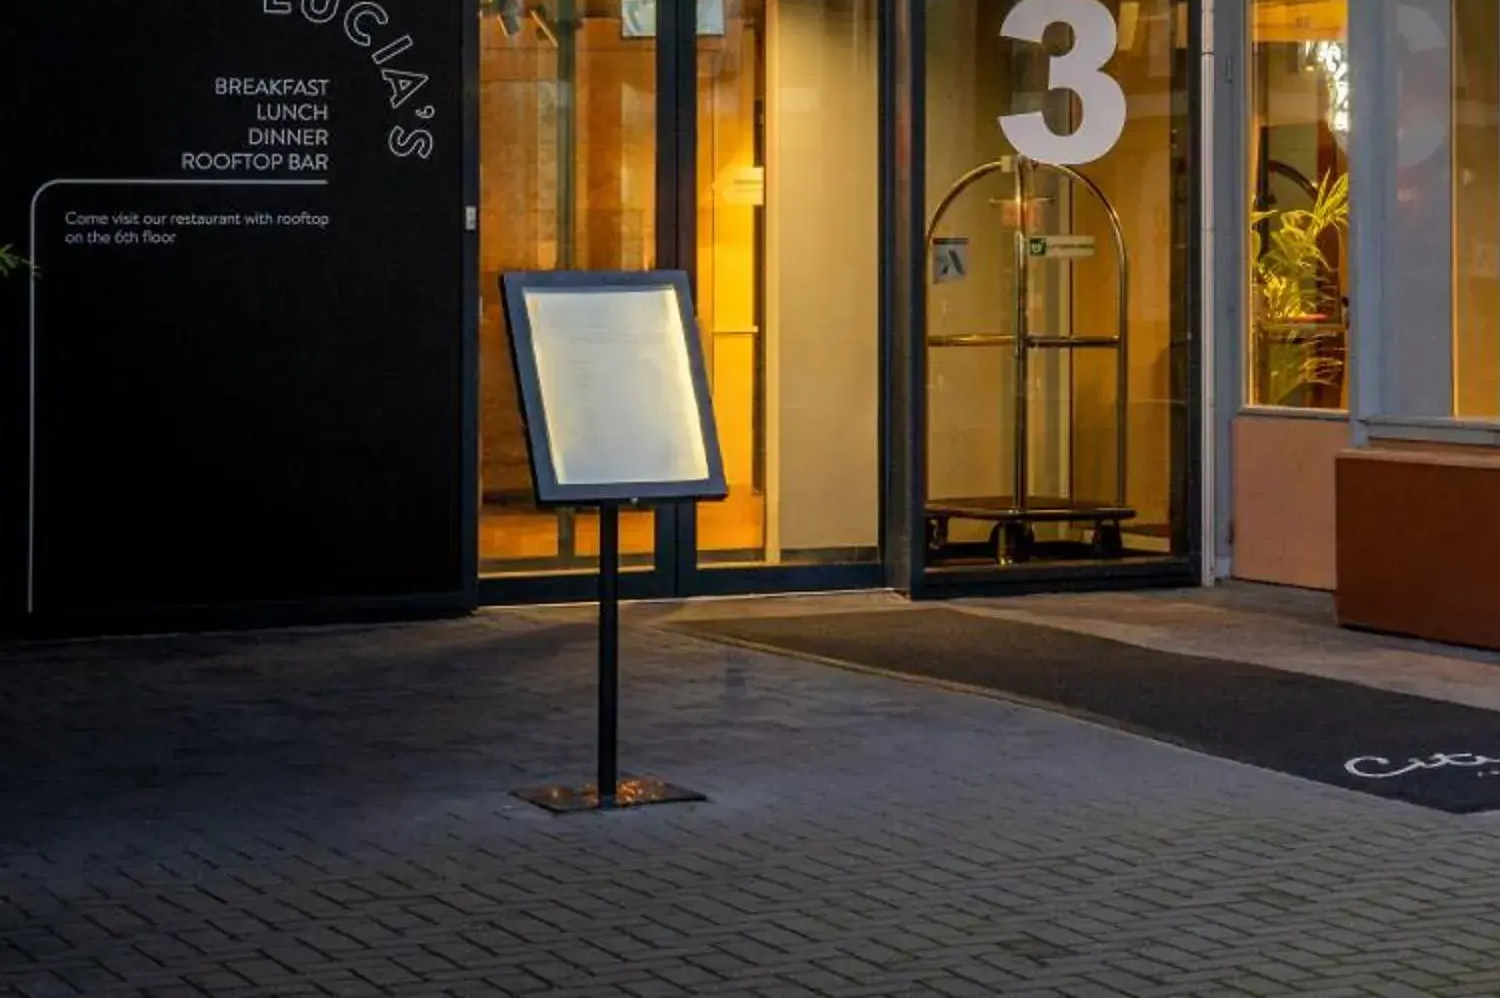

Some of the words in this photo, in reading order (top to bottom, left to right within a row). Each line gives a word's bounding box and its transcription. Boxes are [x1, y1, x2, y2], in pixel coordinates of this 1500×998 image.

[216, 77, 329, 97] BREAKFAST
[258, 103, 328, 121] LUNCH
[248, 127, 329, 146] DINNER
[182, 152, 283, 171] ROOFTOP
[289, 153, 329, 171] BAR
[65, 211, 108, 225] Come
[112, 212, 139, 225] visit
[143, 215, 167, 225] our
[170, 213, 241, 225] restaurant
[245, 212, 273, 225] with
[277, 211, 329, 228] rooftop
[65, 233, 83, 244] on
[87, 230, 111, 243] the
[114, 230, 139, 244] 6th
[143, 230, 176, 244] floor
